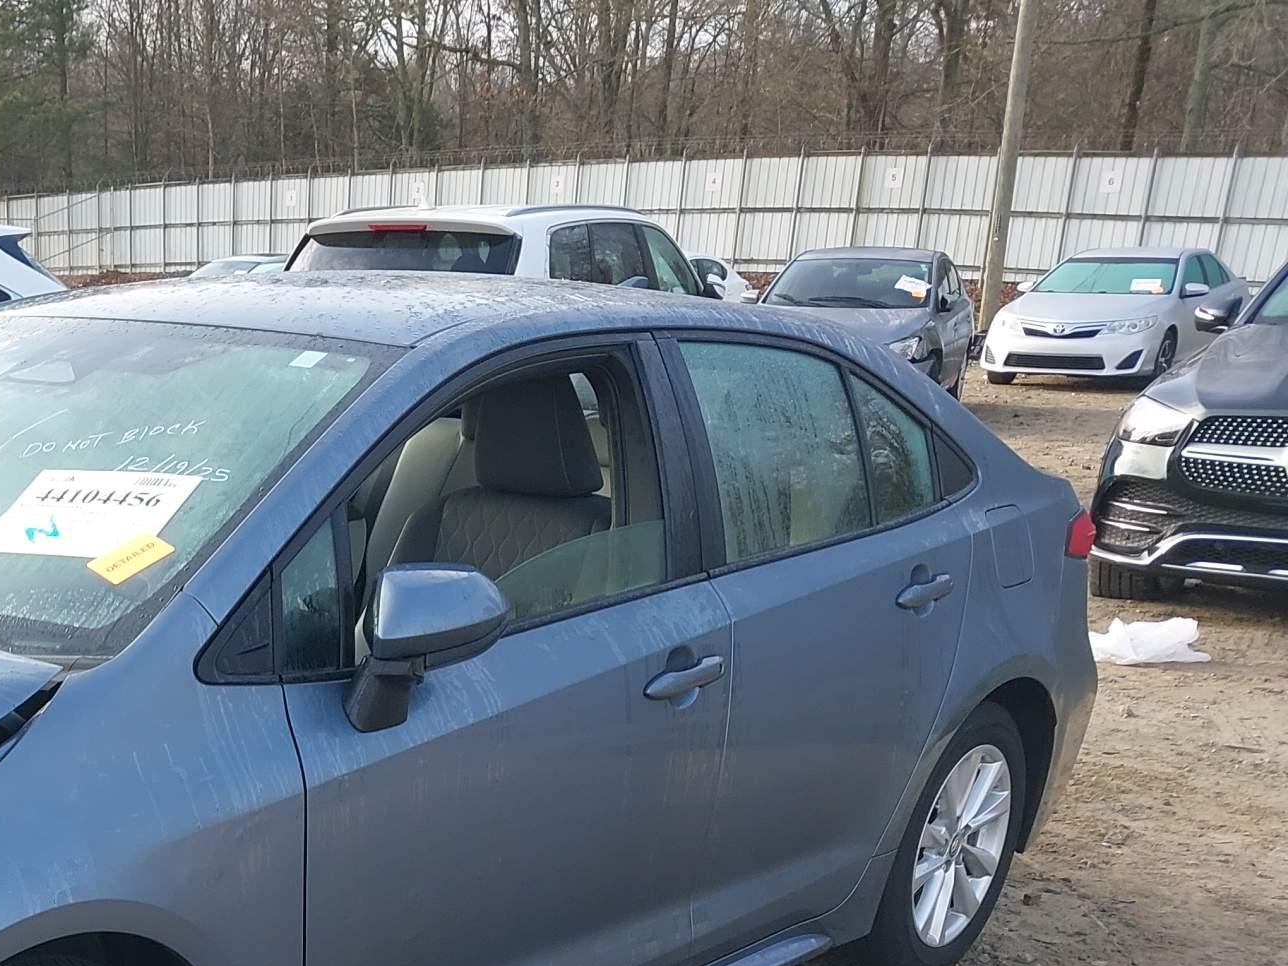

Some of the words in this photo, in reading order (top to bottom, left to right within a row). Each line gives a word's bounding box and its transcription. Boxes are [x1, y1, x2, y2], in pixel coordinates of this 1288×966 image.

[19, 440, 56, 459] DO
[62, 430, 114, 454] NOT
[35, 488, 165, 508] 44104456
